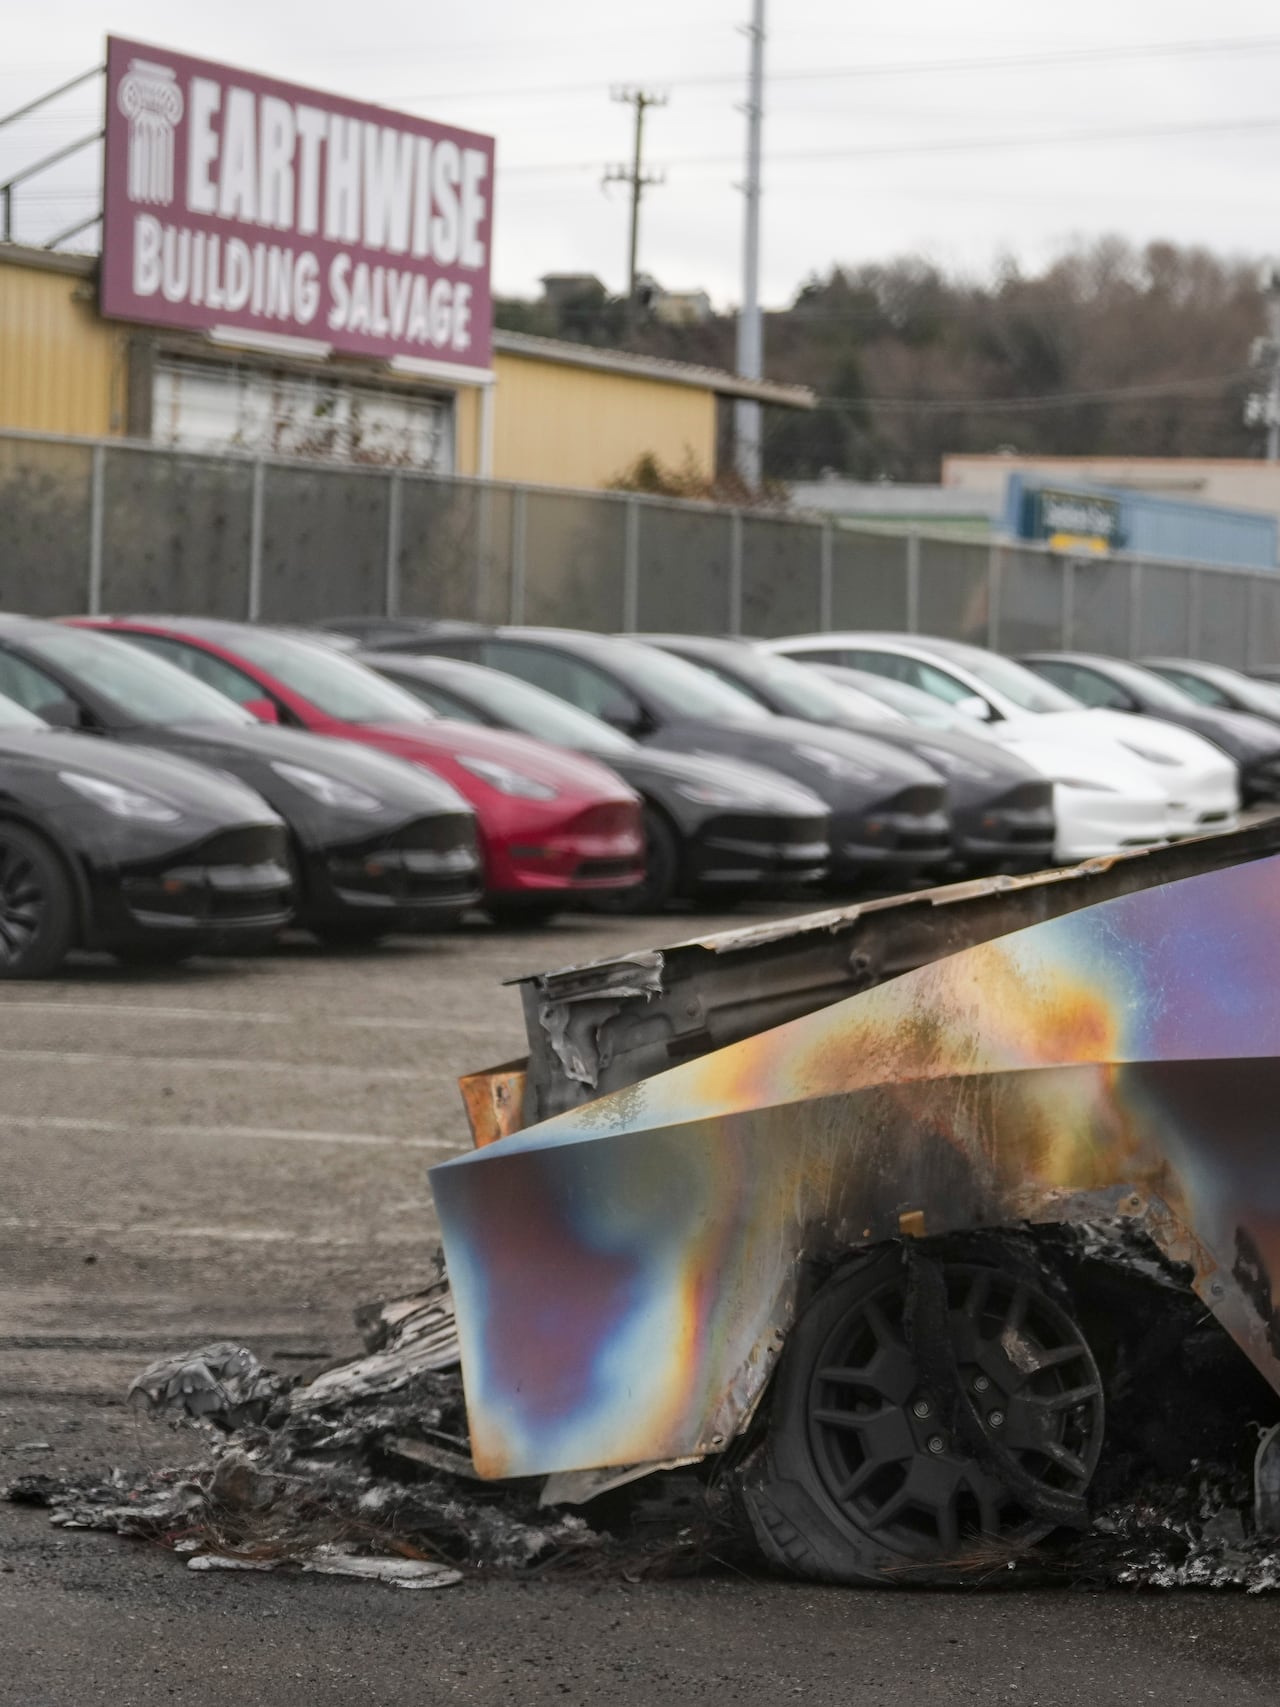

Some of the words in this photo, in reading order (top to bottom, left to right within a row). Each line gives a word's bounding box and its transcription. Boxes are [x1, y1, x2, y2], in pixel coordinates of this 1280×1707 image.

[186, 77, 488, 270] EARTHWISE
[133, 213, 321, 325] BUILDING
[327, 252, 473, 352] SALVAGE
